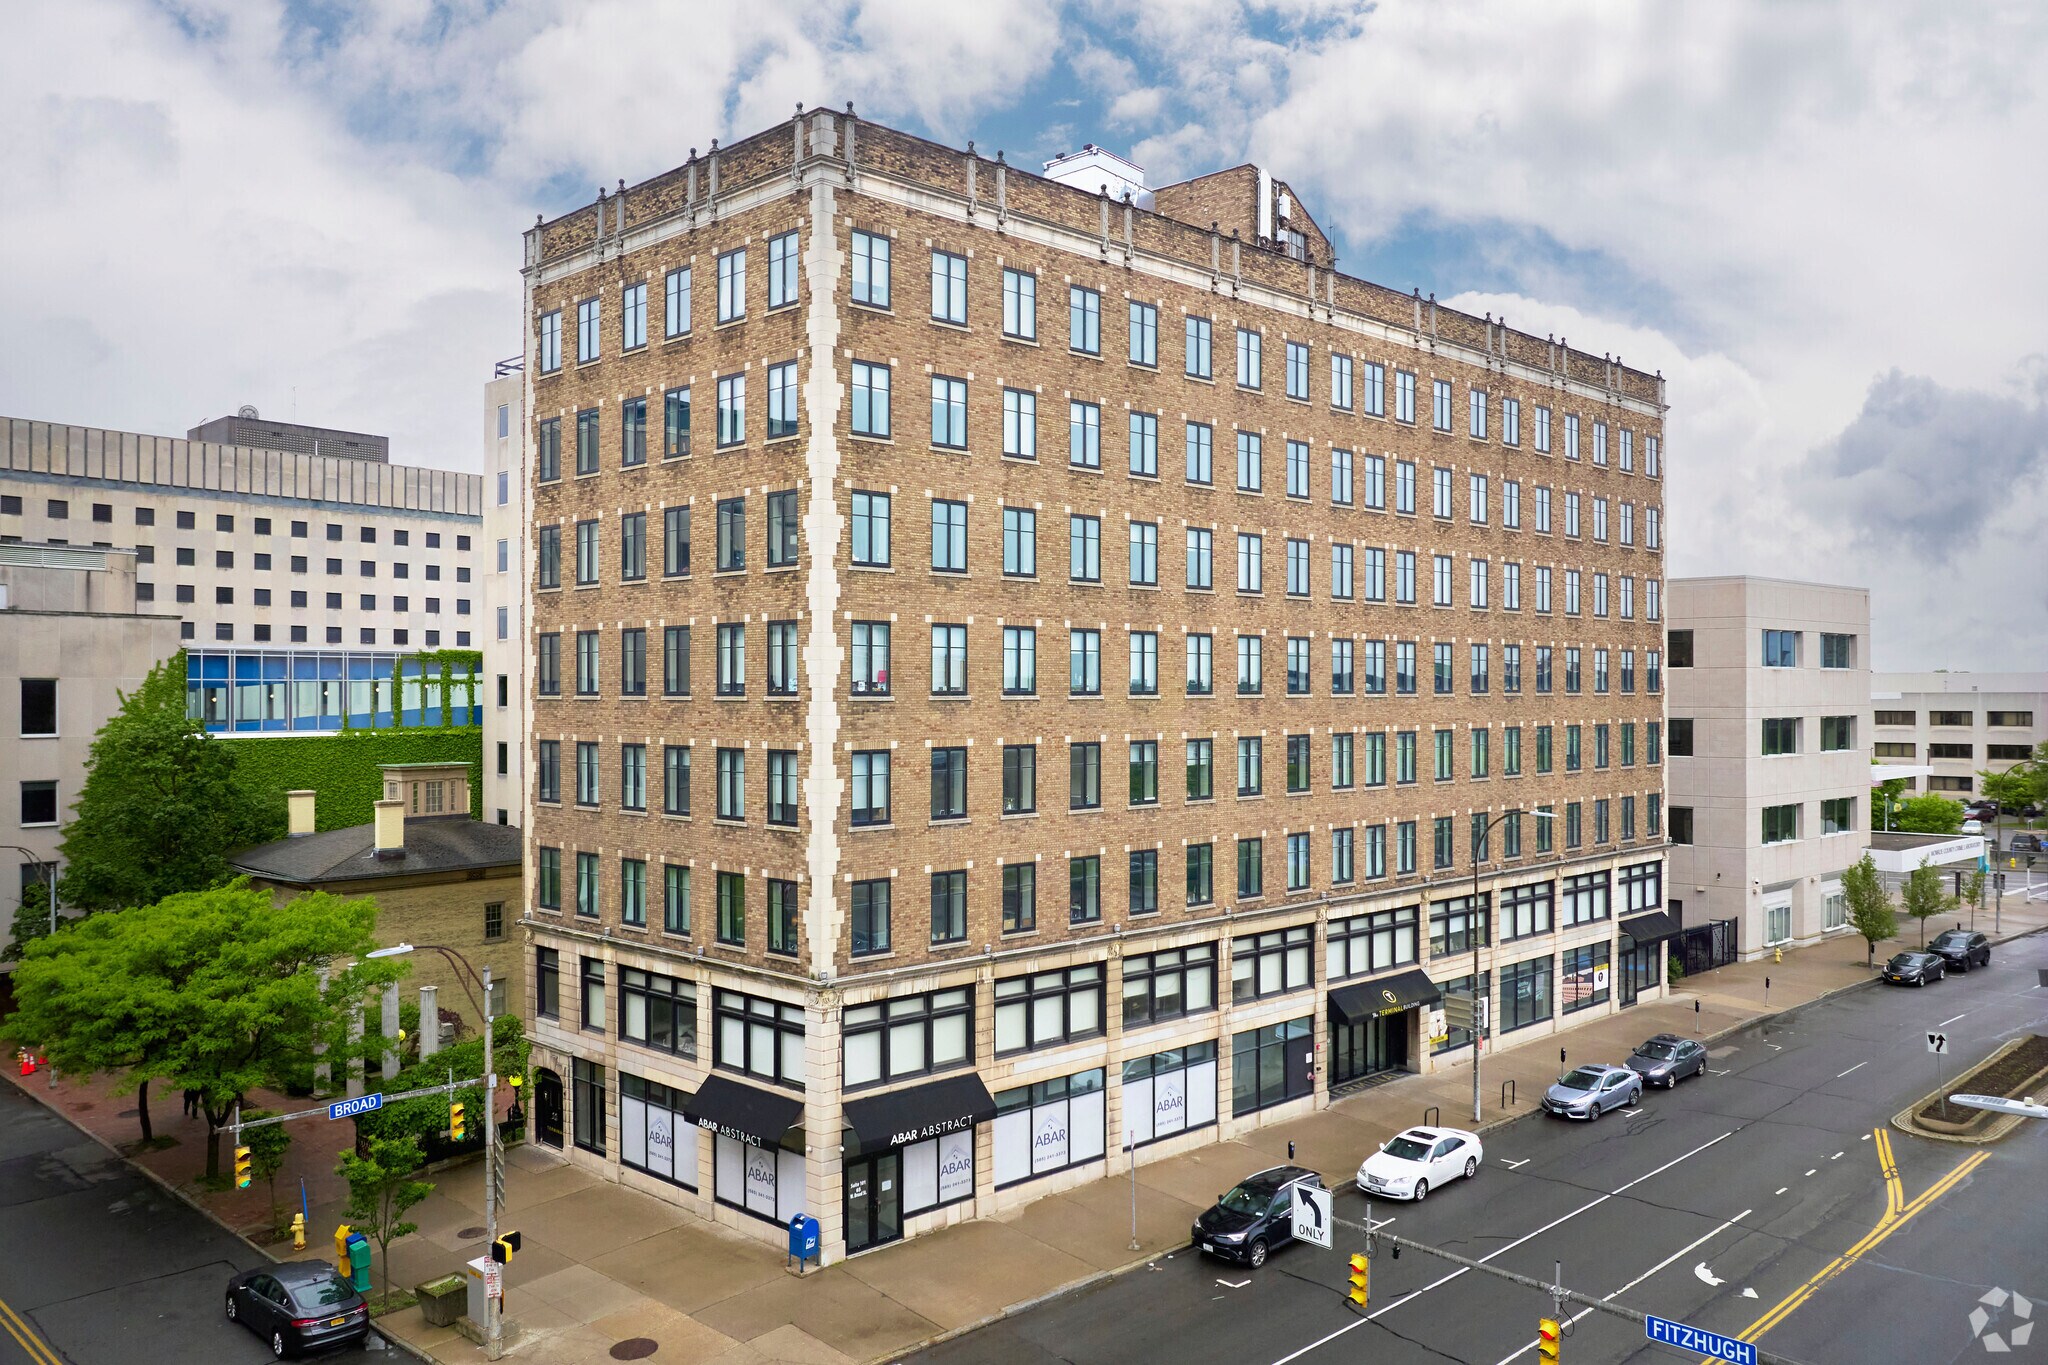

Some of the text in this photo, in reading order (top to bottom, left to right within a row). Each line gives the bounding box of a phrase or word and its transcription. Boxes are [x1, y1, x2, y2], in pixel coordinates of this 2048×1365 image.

[1379, 1005, 1404, 1017] TERMINAL
[1329, 1073, 1405, 1097] TERMINAL
[335, 1096, 377, 1117] BROAD
[1156, 1096, 1183, 1113] ABAR
[649, 1131, 672, 1149] ABAR
[698, 1118, 761, 1147] ABAR ABSTRACT
[890, 1115, 973, 1146] ABAR ABSTRACT
[1035, 1129, 1066, 1148] ABAR
[748, 1166, 774, 1187] ABAR
[941, 1158, 971, 1177] ABAR
[1299, 1224, 1324, 1240] ONLY
[1653, 1320, 1750, 1364] FITZHUGH
